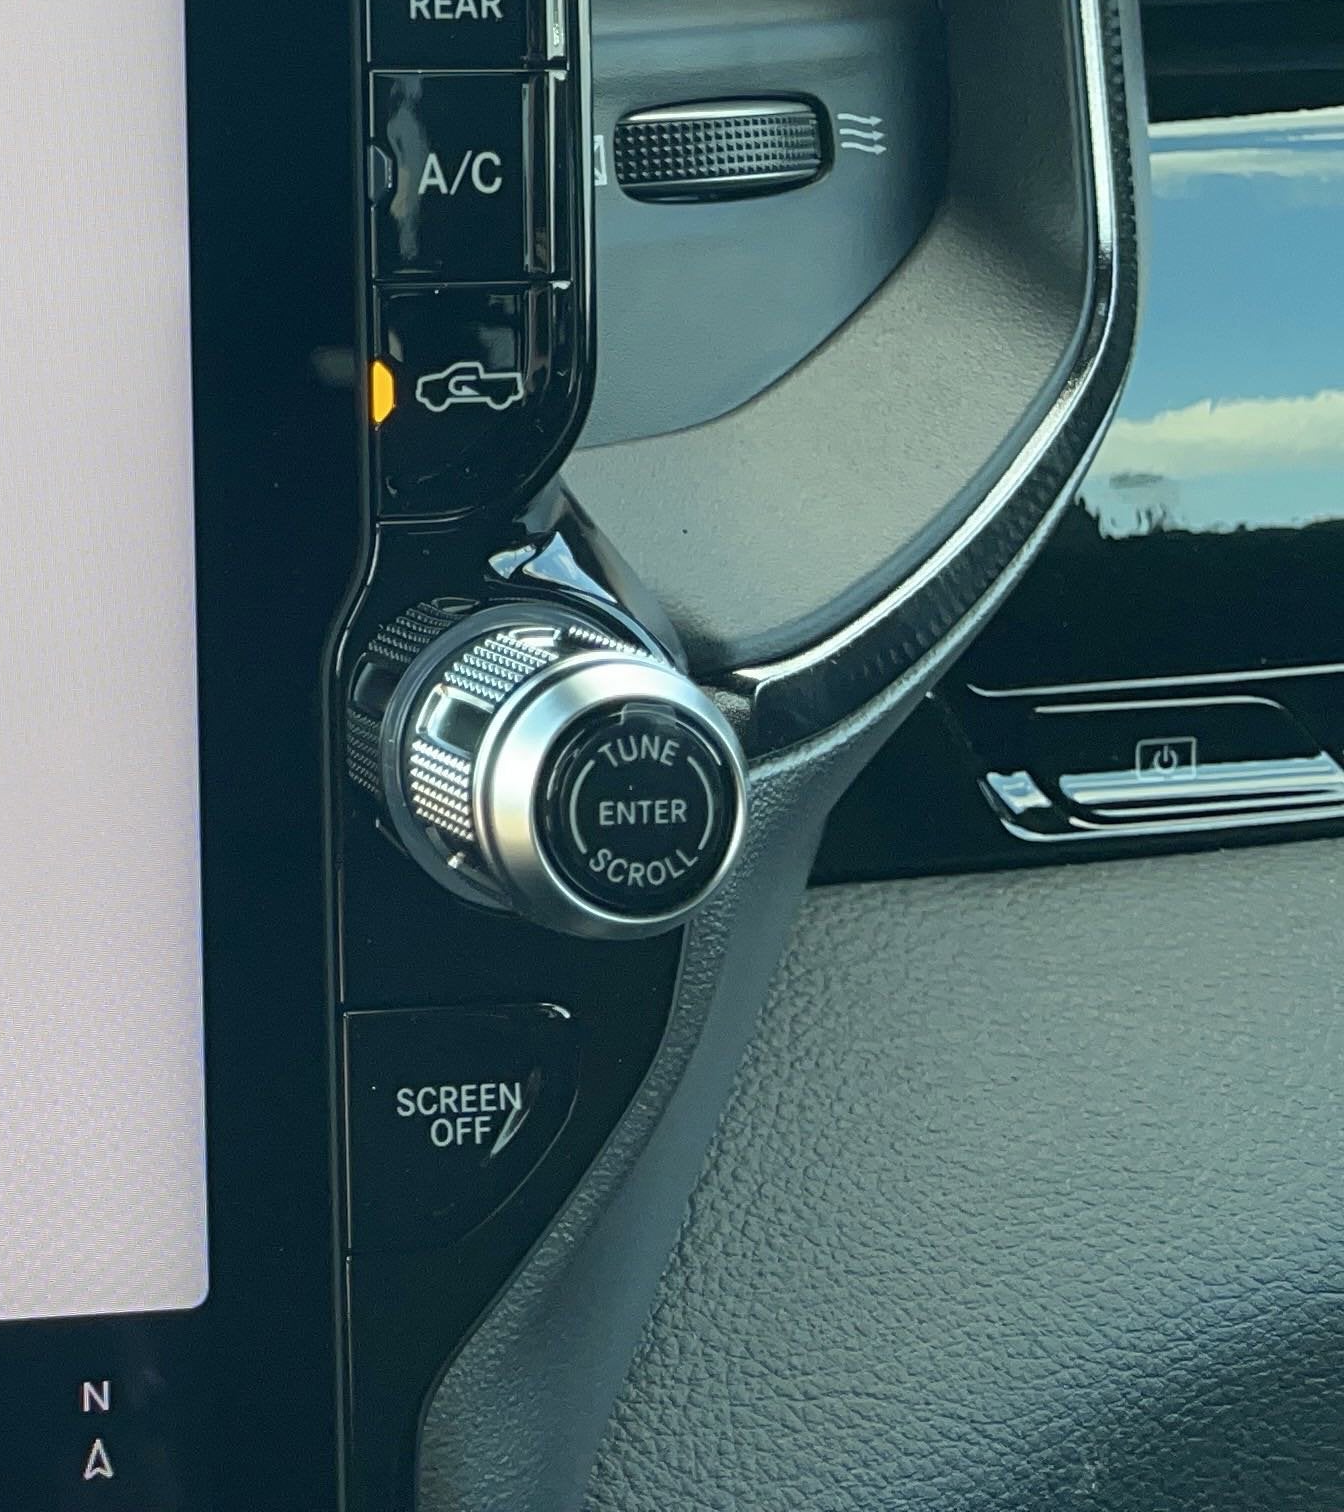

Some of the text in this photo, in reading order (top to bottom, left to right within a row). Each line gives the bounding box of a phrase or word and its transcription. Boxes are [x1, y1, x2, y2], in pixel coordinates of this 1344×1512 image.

[418, 150, 502, 195] A/C
[598, 734, 680, 768] TUNE
[599, 799, 687, 826] ENTER
[589, 848, 699, 887] SCROLL
[396, 1082, 523, 1117] SCREEN
[430, 1116, 492, 1147] OFF
[82, 1381, 110, 1412] N
